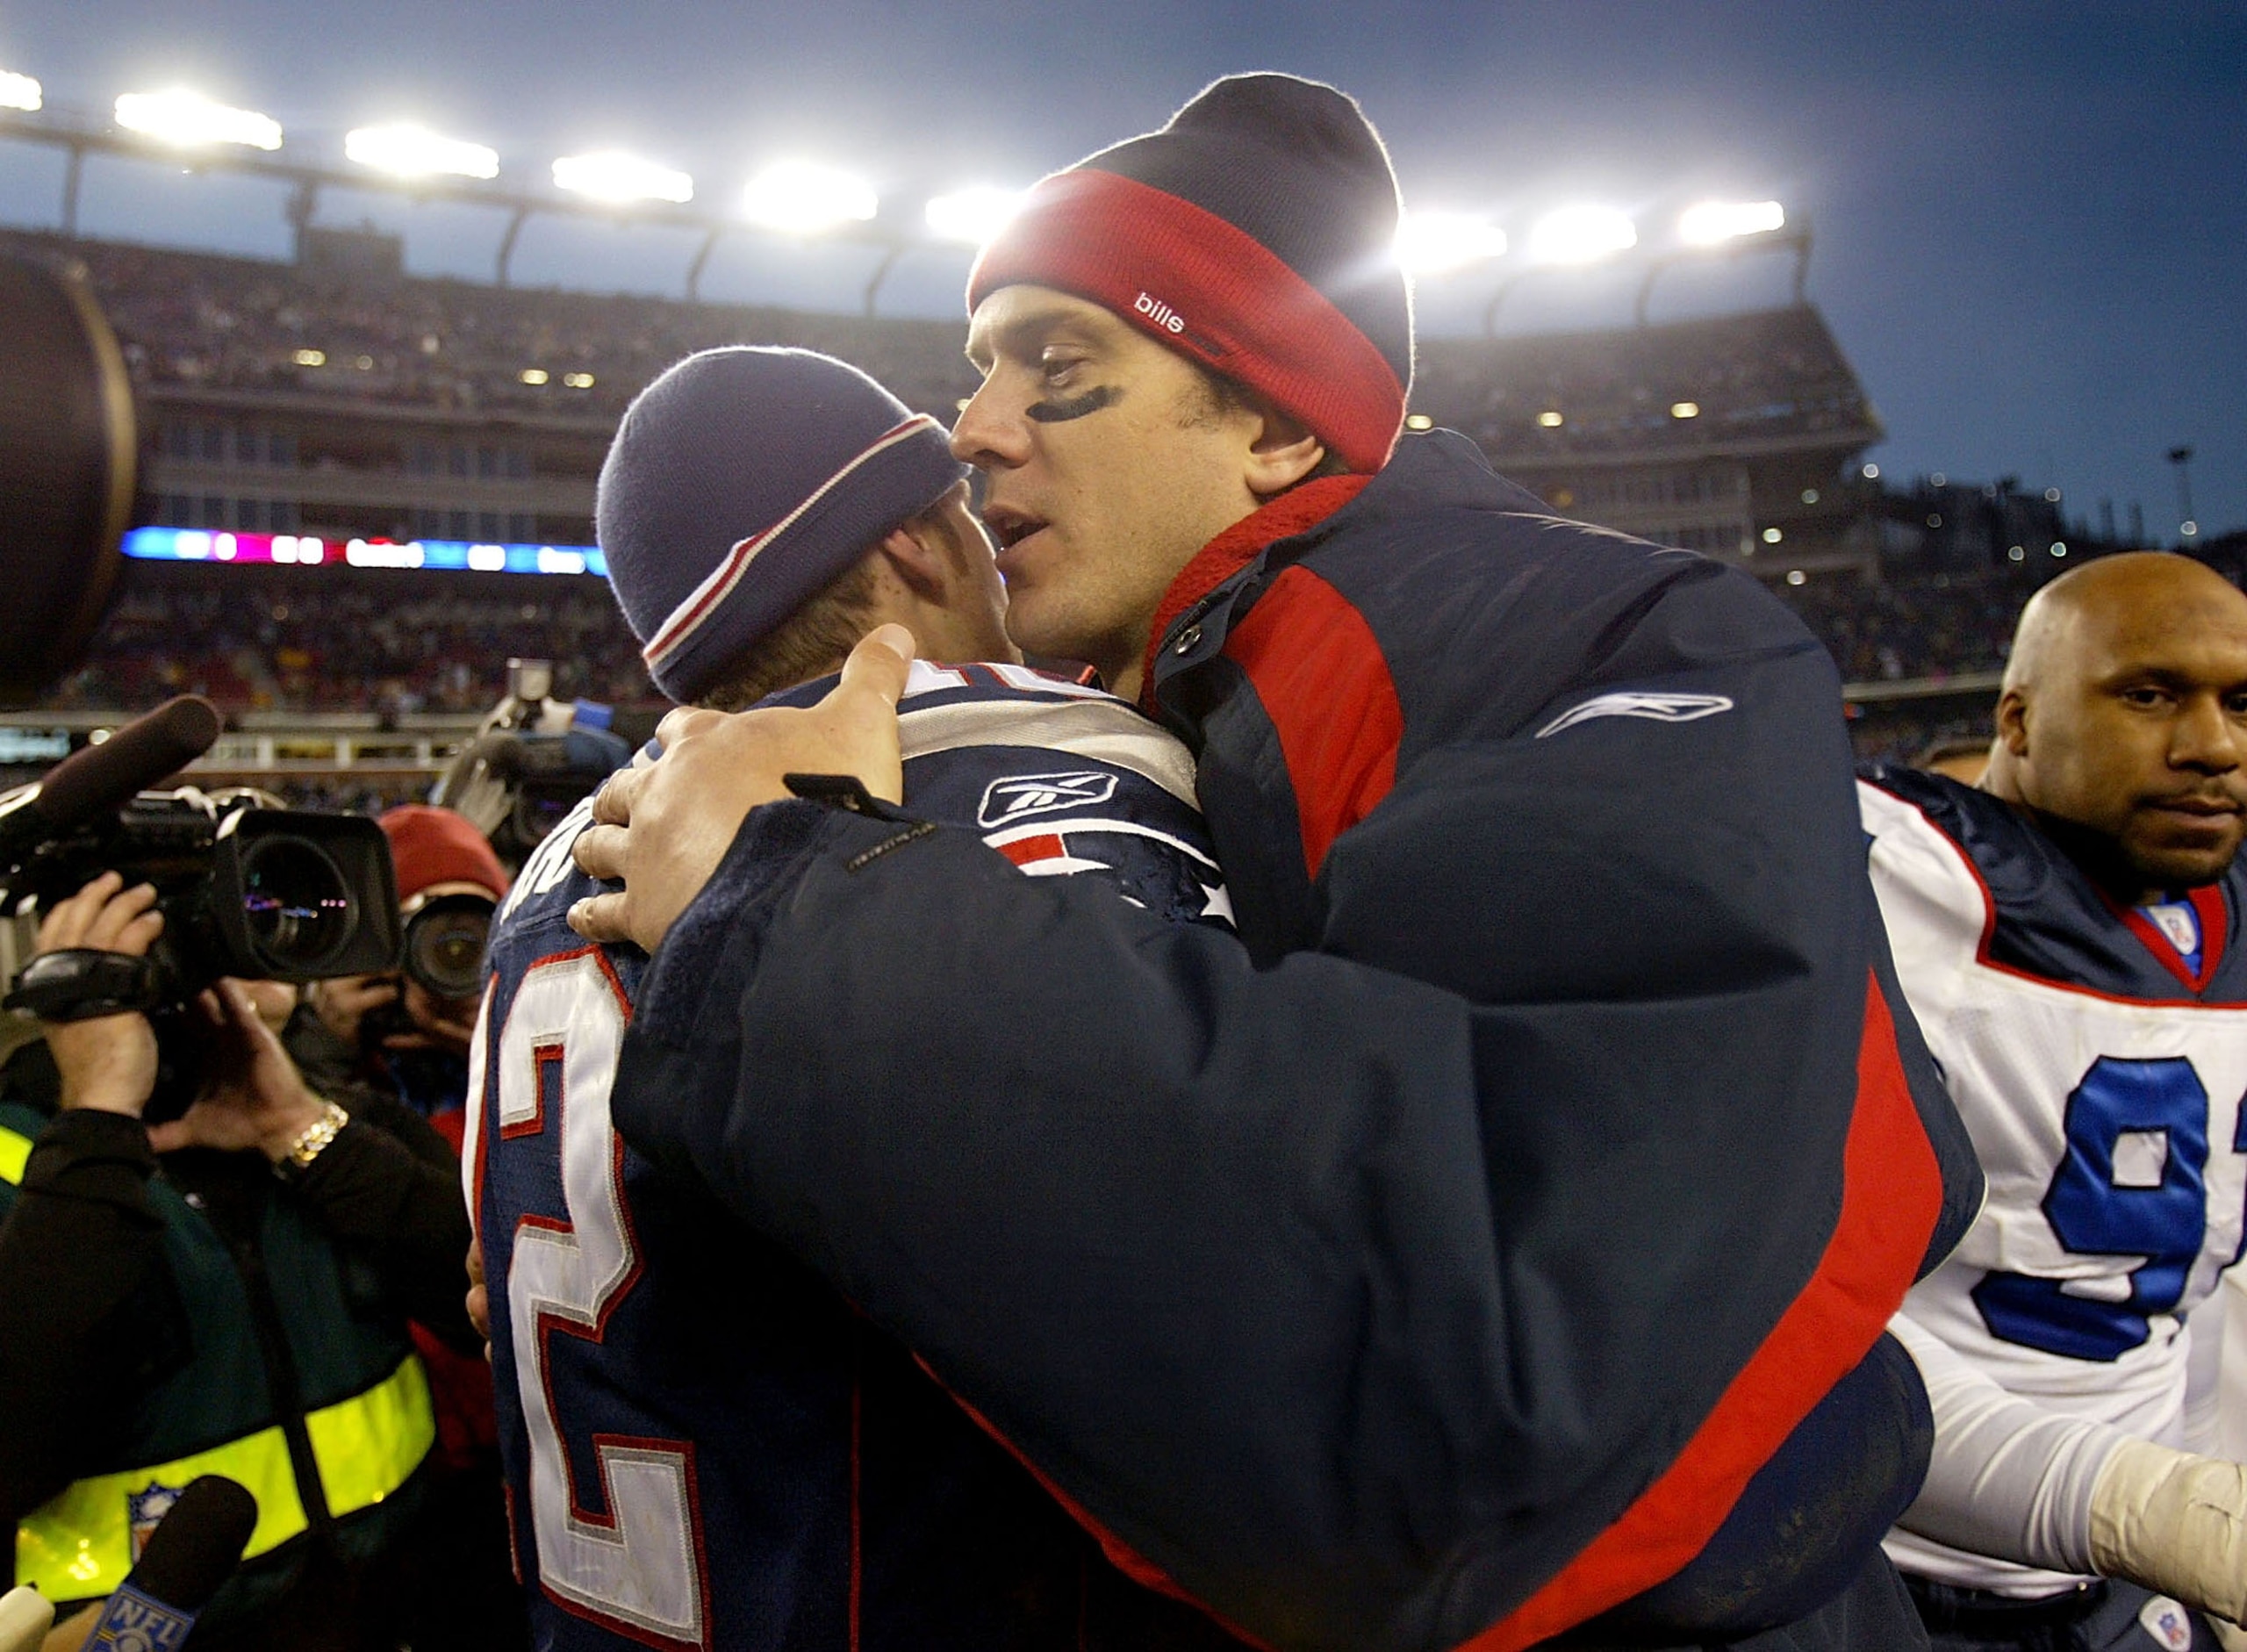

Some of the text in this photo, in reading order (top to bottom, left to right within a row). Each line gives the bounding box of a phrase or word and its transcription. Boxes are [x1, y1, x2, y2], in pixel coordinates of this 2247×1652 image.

[1133, 291, 1185, 334] bills
[462, 941, 714, 1652] 2
[1970, 1053, 2247, 1362] 9
[111, 1597, 177, 1645] NFL
